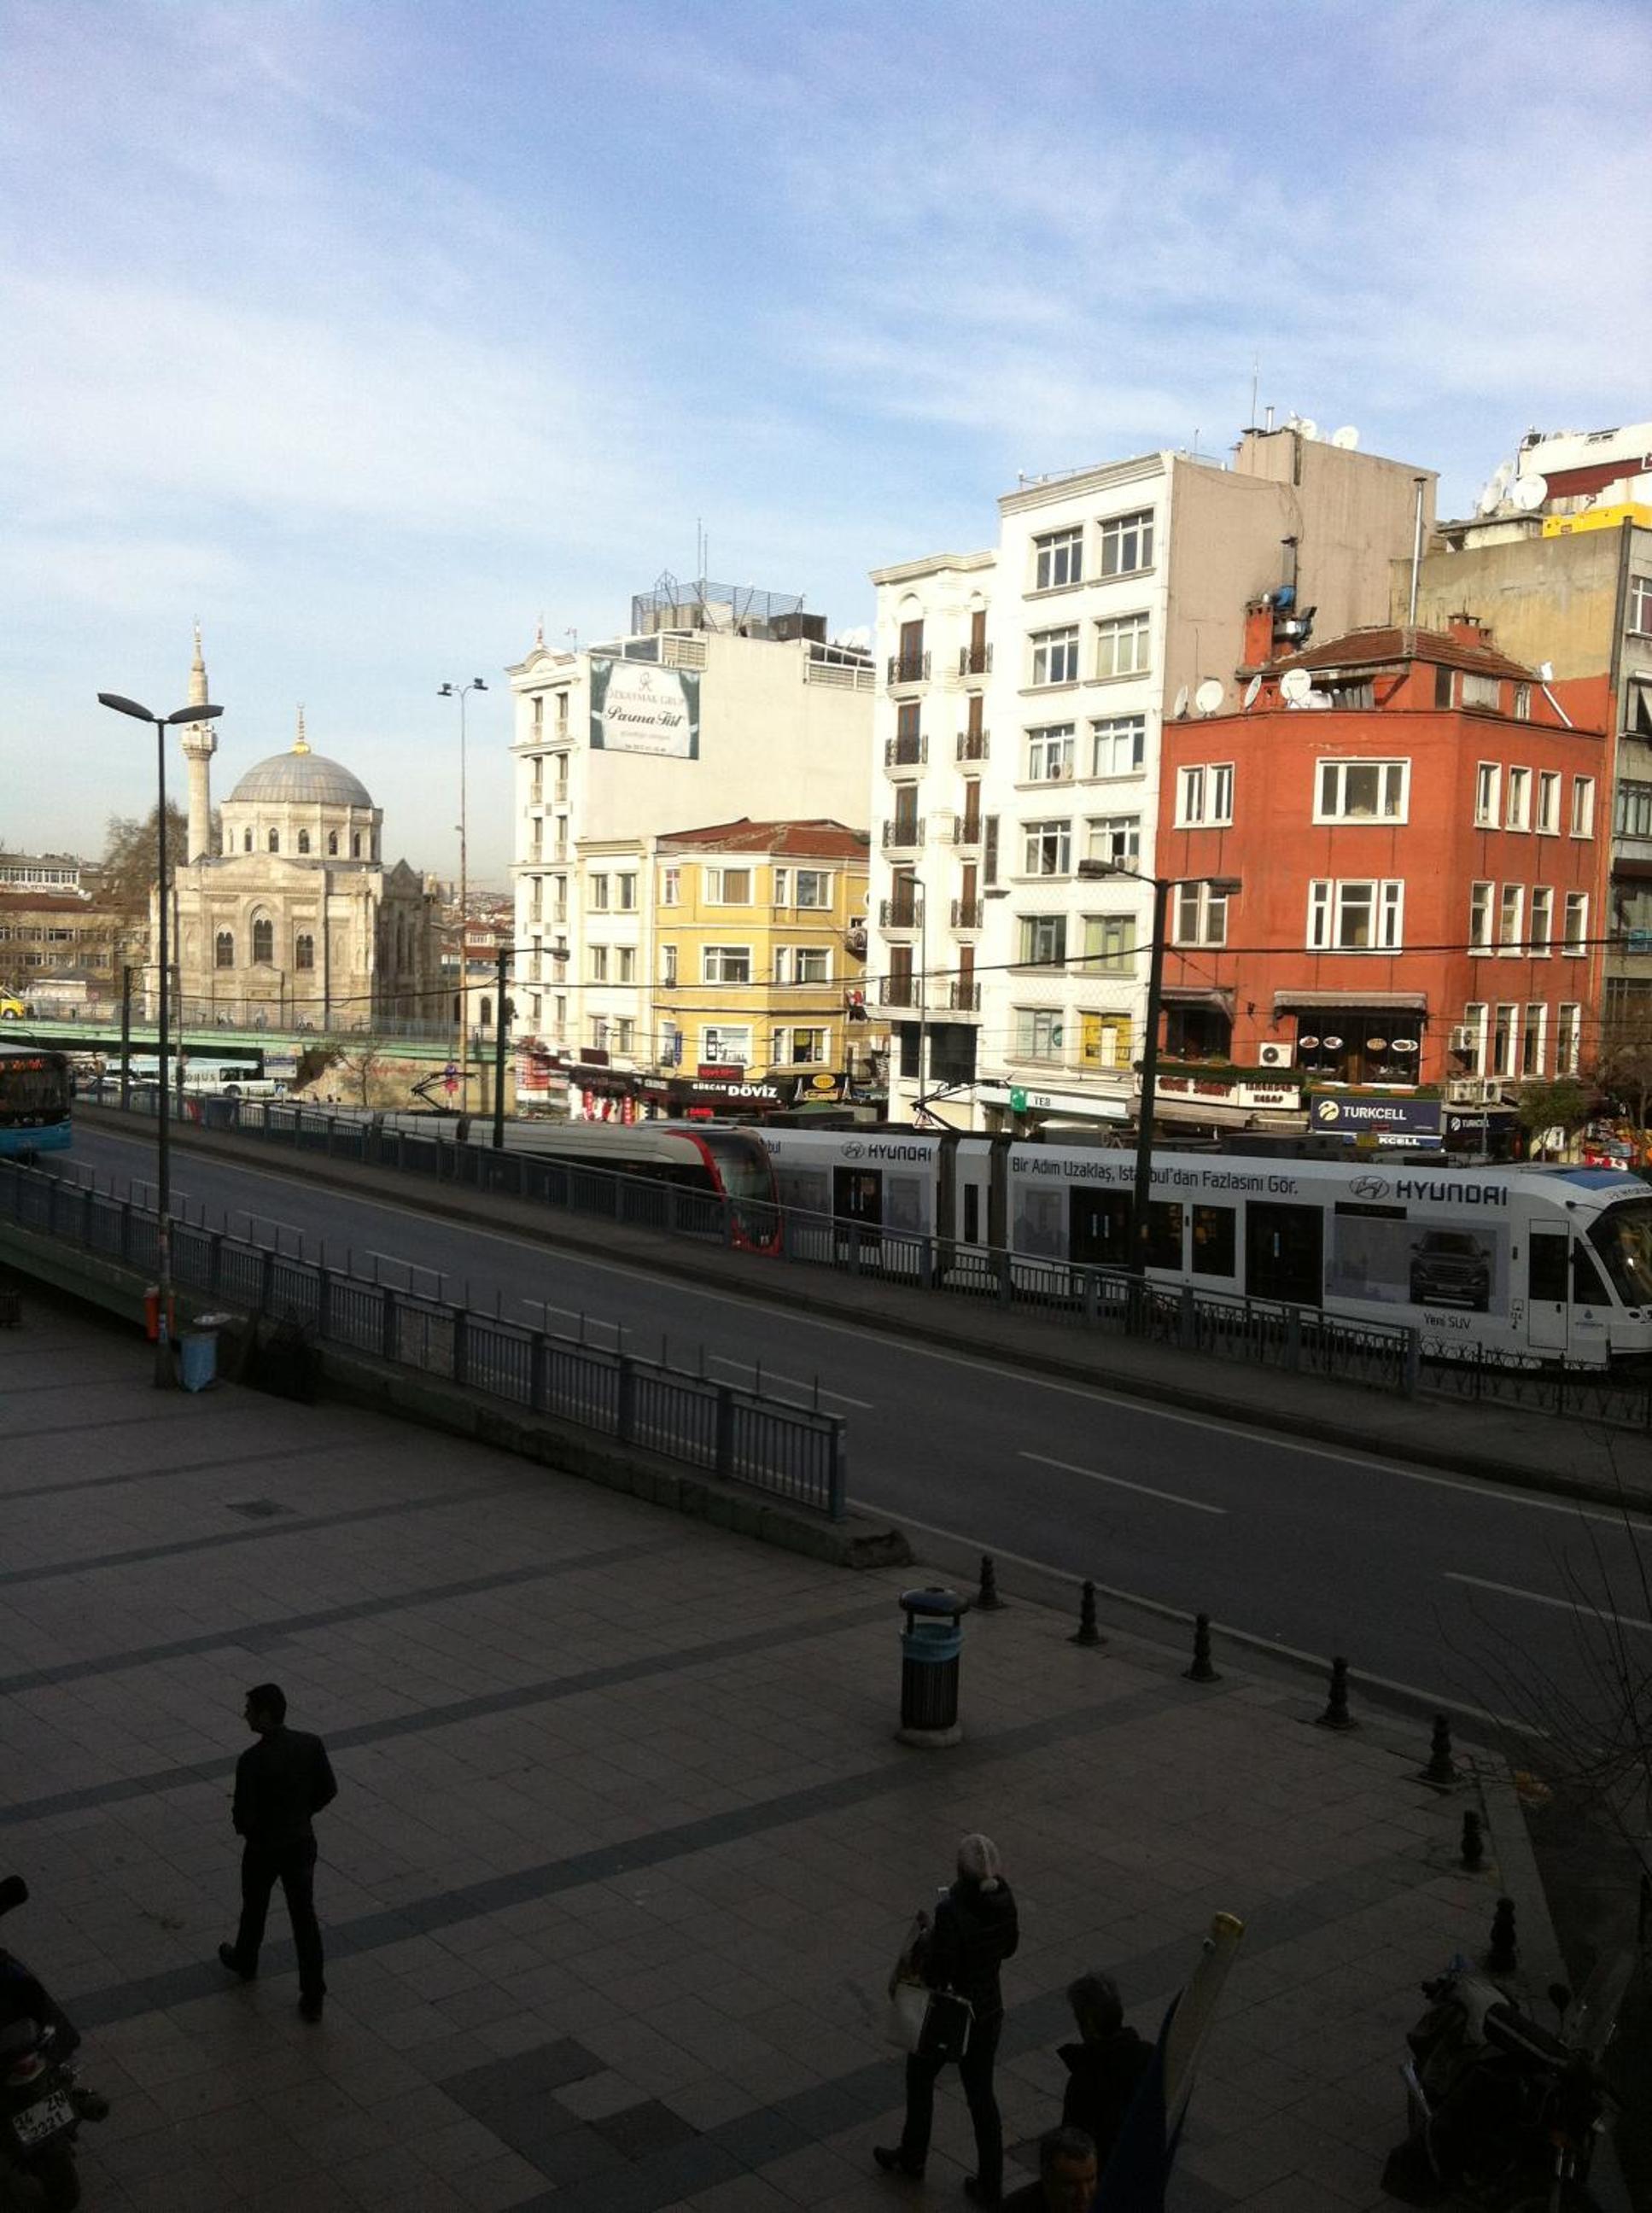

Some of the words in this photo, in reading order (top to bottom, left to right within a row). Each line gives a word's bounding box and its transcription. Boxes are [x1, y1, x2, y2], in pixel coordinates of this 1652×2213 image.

[727, 1084, 778, 1098] DÖVİZ
[1034, 1095, 1051, 1107] TEB
[1343, 1106, 1407, 1121] TURKCELL
[867, 1144, 931, 1162] HYUNDAI
[1013, 1156, 1028, 1172] Bir
[1396, 1180, 1508, 1206] HYUNDAI
[1423, 1311, 1446, 1326] Yeni
[1449, 1316, 1472, 1330] SUV
